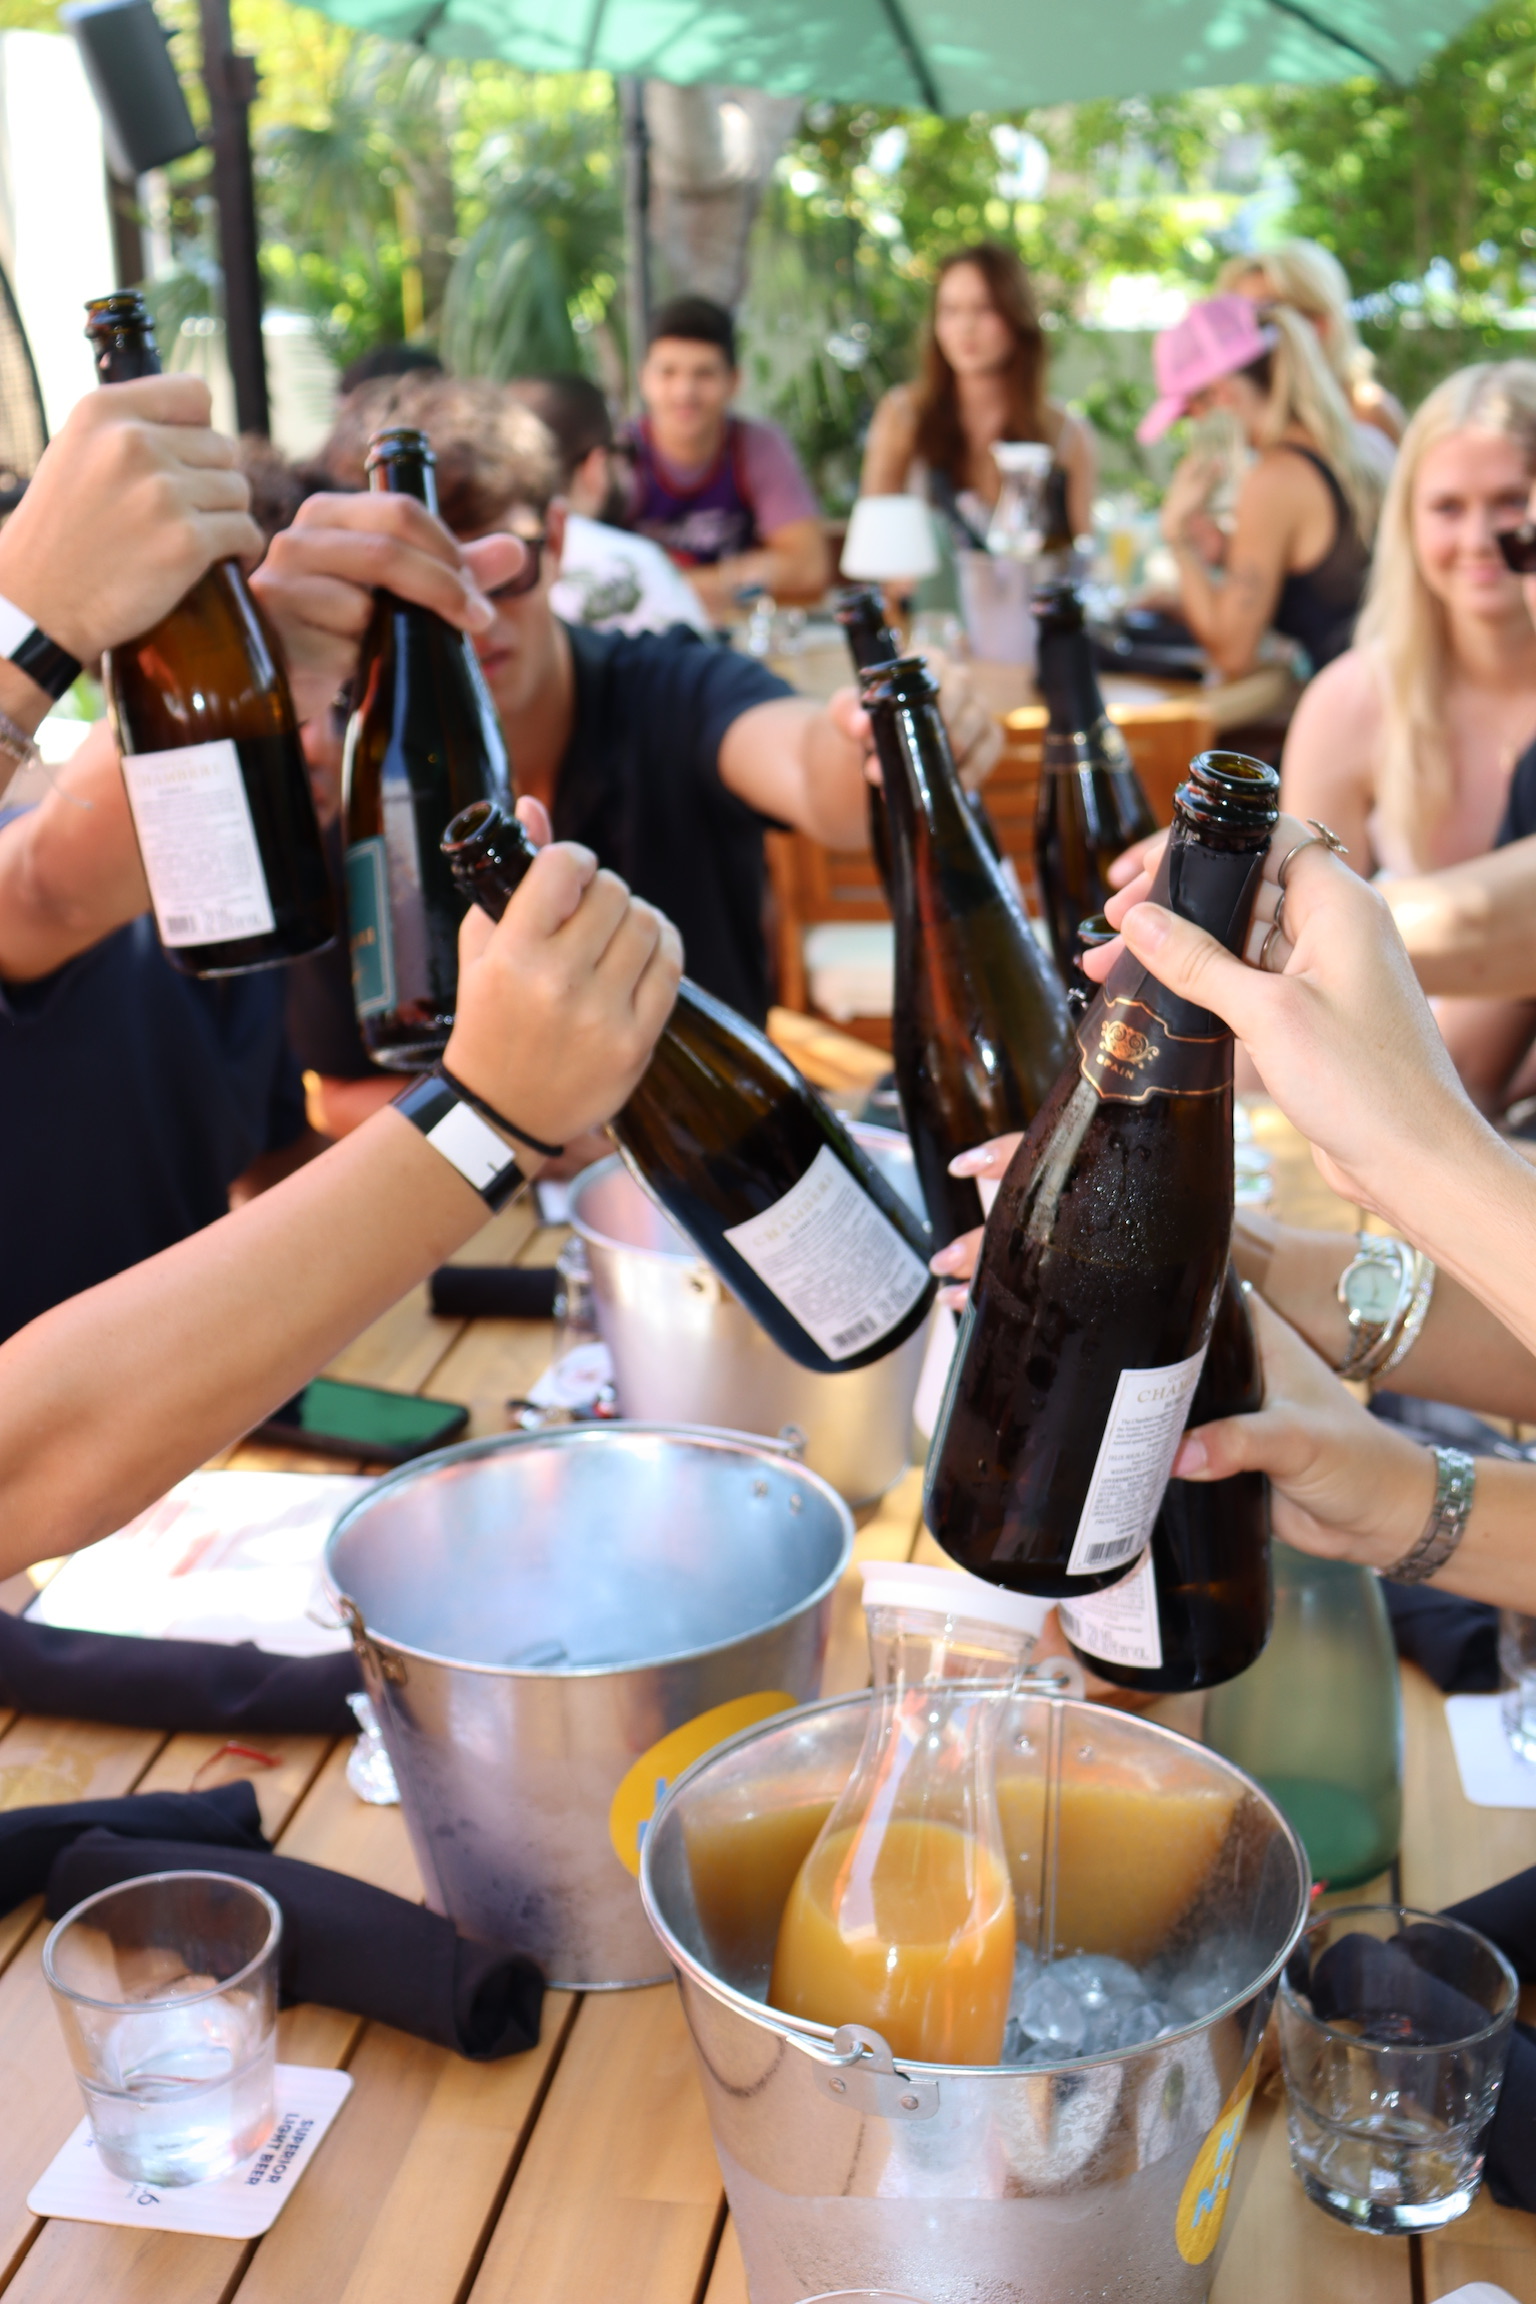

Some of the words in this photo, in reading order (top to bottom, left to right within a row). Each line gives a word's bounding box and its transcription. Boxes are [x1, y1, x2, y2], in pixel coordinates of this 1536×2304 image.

[266, 2113, 300, 2151] LIGHT
[244, 2153, 275, 2186] BEER
[265, 2119, 315, 2184] SUPERIOR
